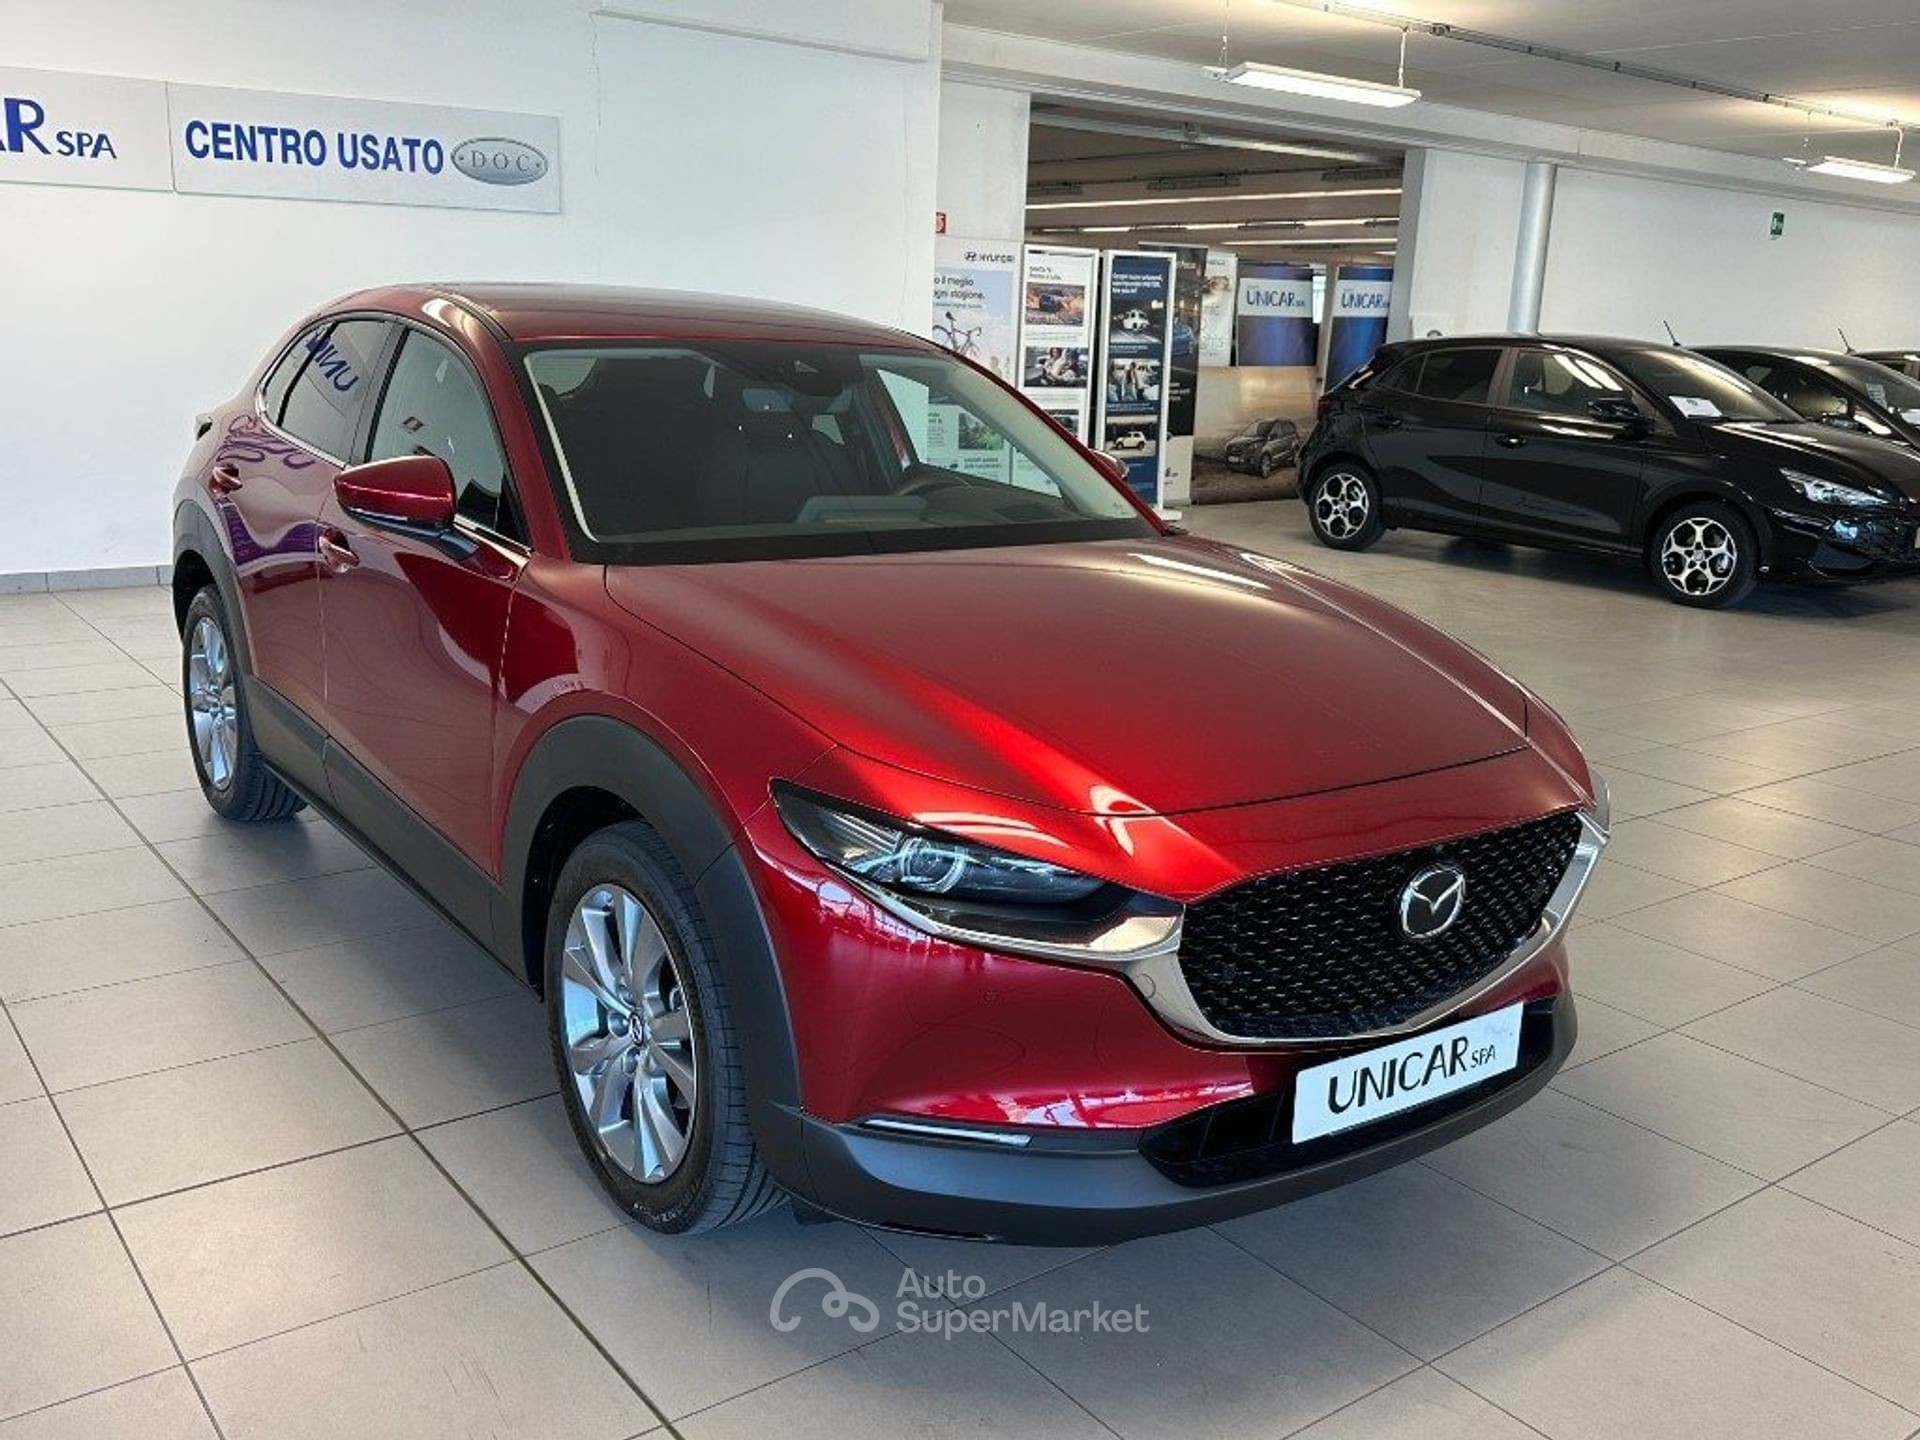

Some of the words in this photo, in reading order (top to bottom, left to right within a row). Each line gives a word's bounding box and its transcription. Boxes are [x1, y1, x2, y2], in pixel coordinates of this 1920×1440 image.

[0, 97, 52, 155] R
[56, 131, 117, 159] SPA
[185, 120, 327, 168] CENTRO
[337, 133, 444, 175] USATO
[1246, 290, 1295, 307] UNICAR
[1341, 292, 1384, 309] UNICAR
[1328, 1036, 1469, 1114] UNICAR
[1470, 1044, 1497, 1069] SPA
